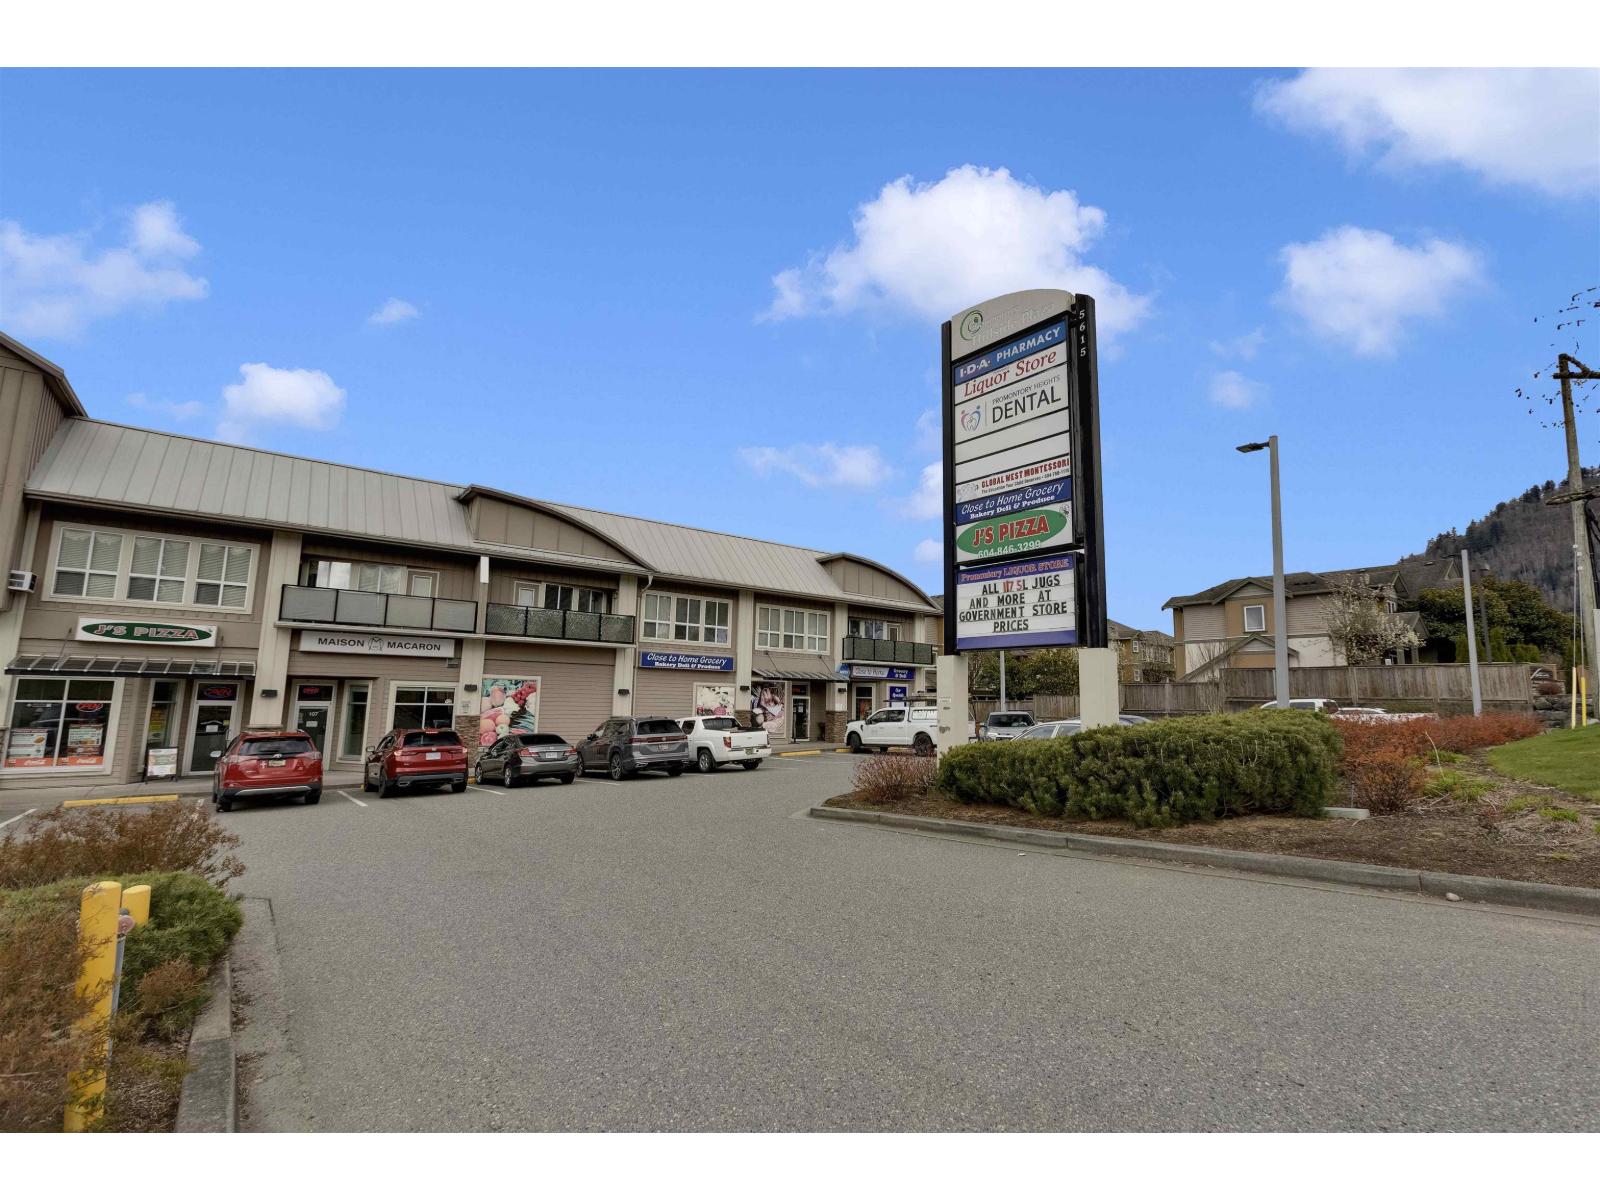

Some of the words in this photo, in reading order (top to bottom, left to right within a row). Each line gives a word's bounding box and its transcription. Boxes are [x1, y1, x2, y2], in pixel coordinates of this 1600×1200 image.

[996, 327, 1061, 362] PHARMACY
[1079, 309, 1087, 357] 5615
[964, 369, 1010, 397] Liquor
[1015, 351, 1057, 377] Store
[992, 385, 1032, 405] PROMONTORY
[1033, 374, 1061, 390] HEIGHTS
[992, 386, 1062, 423] DENTAL
[981, 477, 1005, 488] GLOBAL
[1005, 471, 1024, 482] WEST
[1024, 457, 1070, 477] MONTESSORI
[961, 503, 983, 515] Close
[985, 499, 995, 508] to
[996, 492, 1023, 506] Home
[1025, 482, 1065, 499] Grocery
[970, 509, 995, 520] Bakery
[996, 505, 1012, 516] Deli
[1022, 494, 1055, 508] Produce
[973, 526, 994, 547] J'S
[998, 514, 1050, 543] PIZZA
[969, 598, 989, 609] AND
[997, 593, 1025, 607] MORE
[1038, 589, 1051, 602] AT
[982, 583, 999, 596] ALL
[1032, 574, 1060, 589] JUGS
[959, 606, 1025, 622] GOVERNMENT
[1032, 601, 1068, 616] STORE
[94, 624, 127, 636] J'S
[133, 627, 199, 640] PIZZA
[993, 619, 1029, 633] PRICES
[318, 637, 365, 647] MAISON
[387, 641, 441, 651] MACARON
[647, 652, 667, 662] Close
[668, 654, 677, 662] to
[678, 655, 699, 663] Home
[700, 656, 728, 666] Grocery
